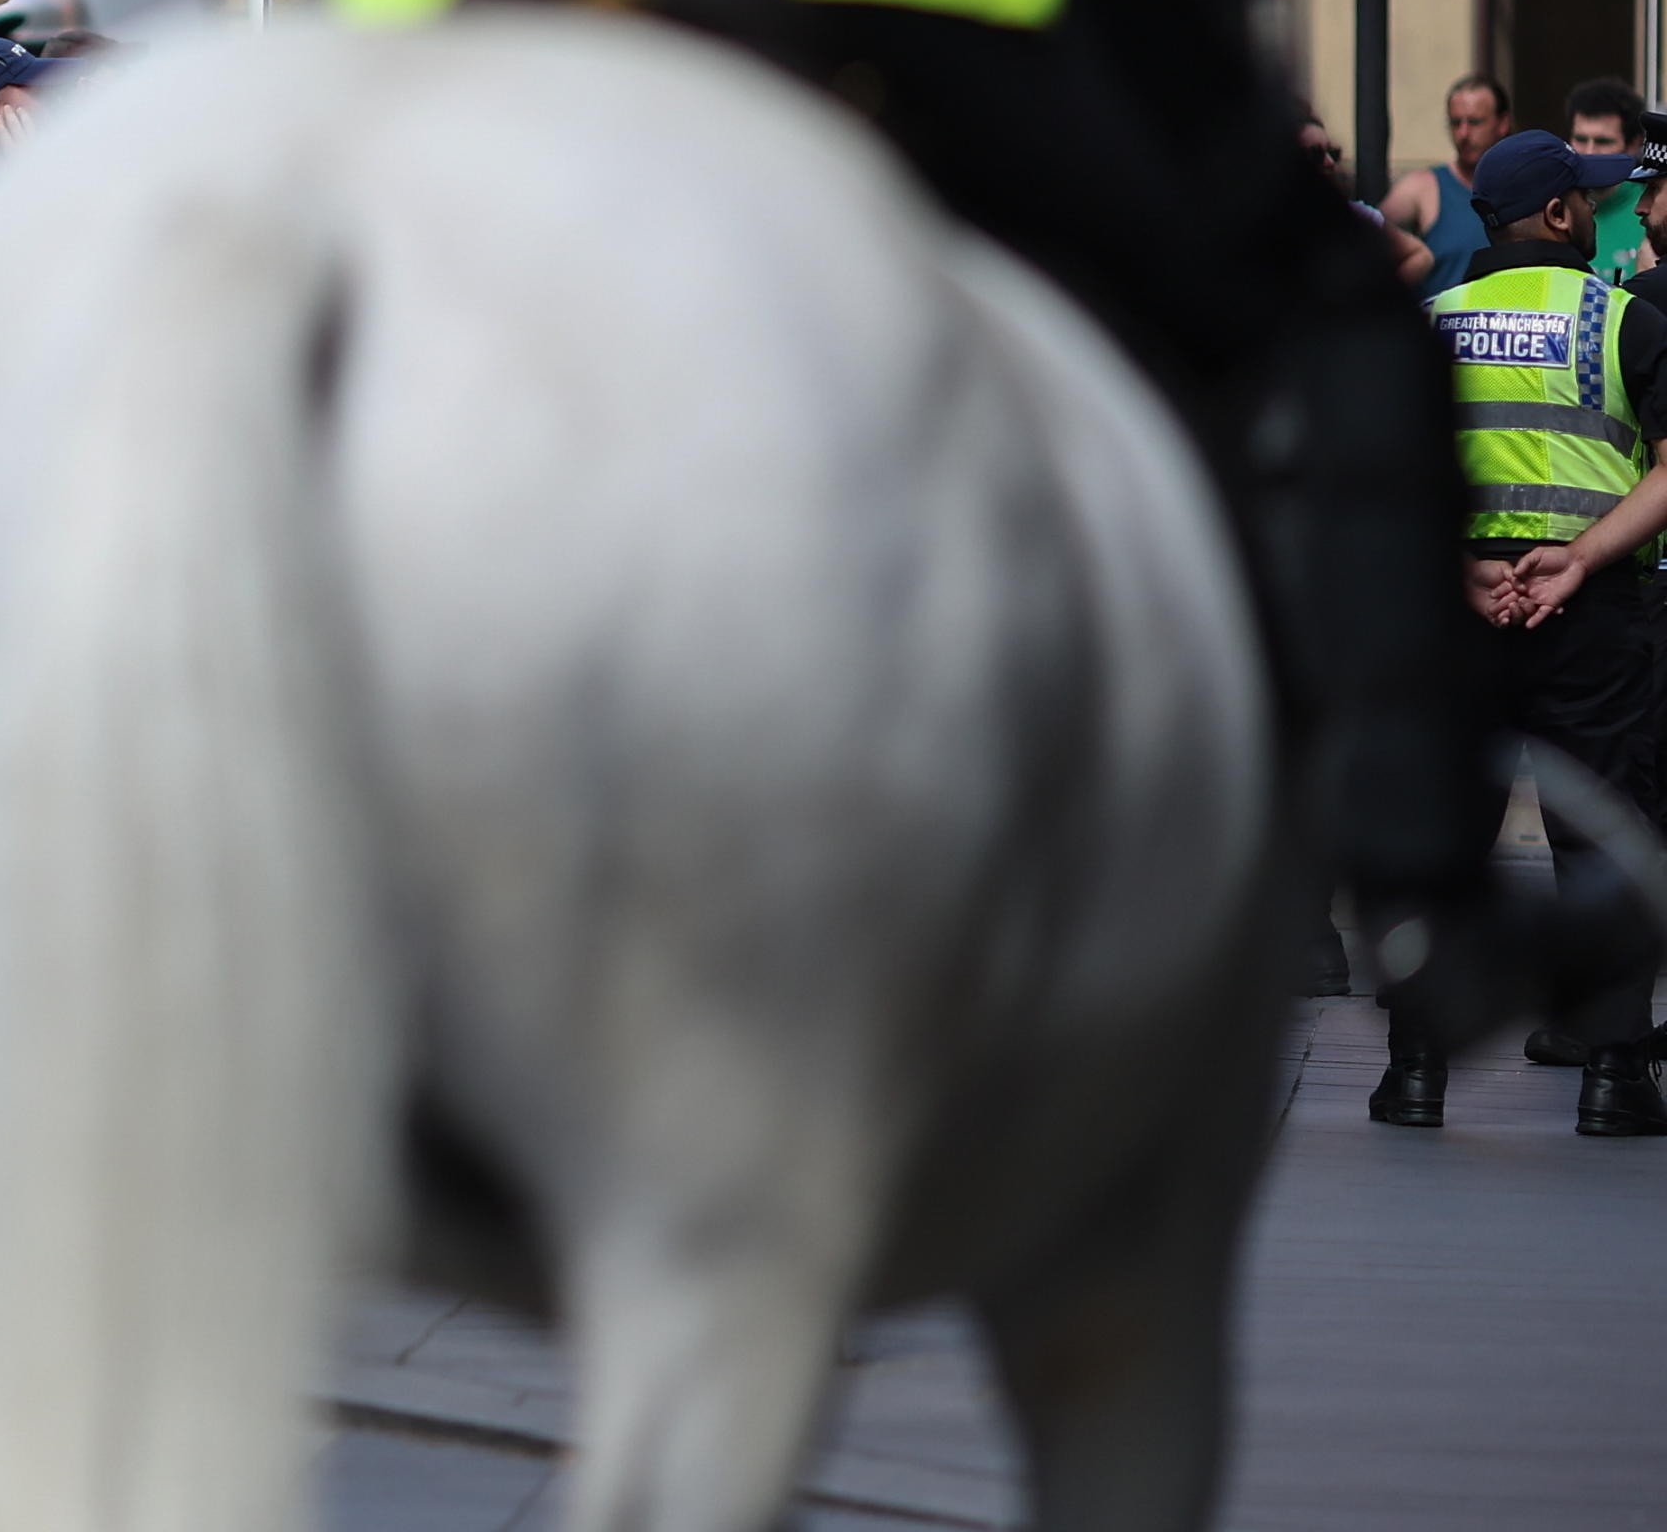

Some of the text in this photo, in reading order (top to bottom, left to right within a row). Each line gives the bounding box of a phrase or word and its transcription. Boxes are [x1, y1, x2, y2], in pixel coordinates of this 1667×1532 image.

[1440, 315, 1565, 334] GREATER MANCHESTER
[1454, 331, 1546, 358] POLICE
